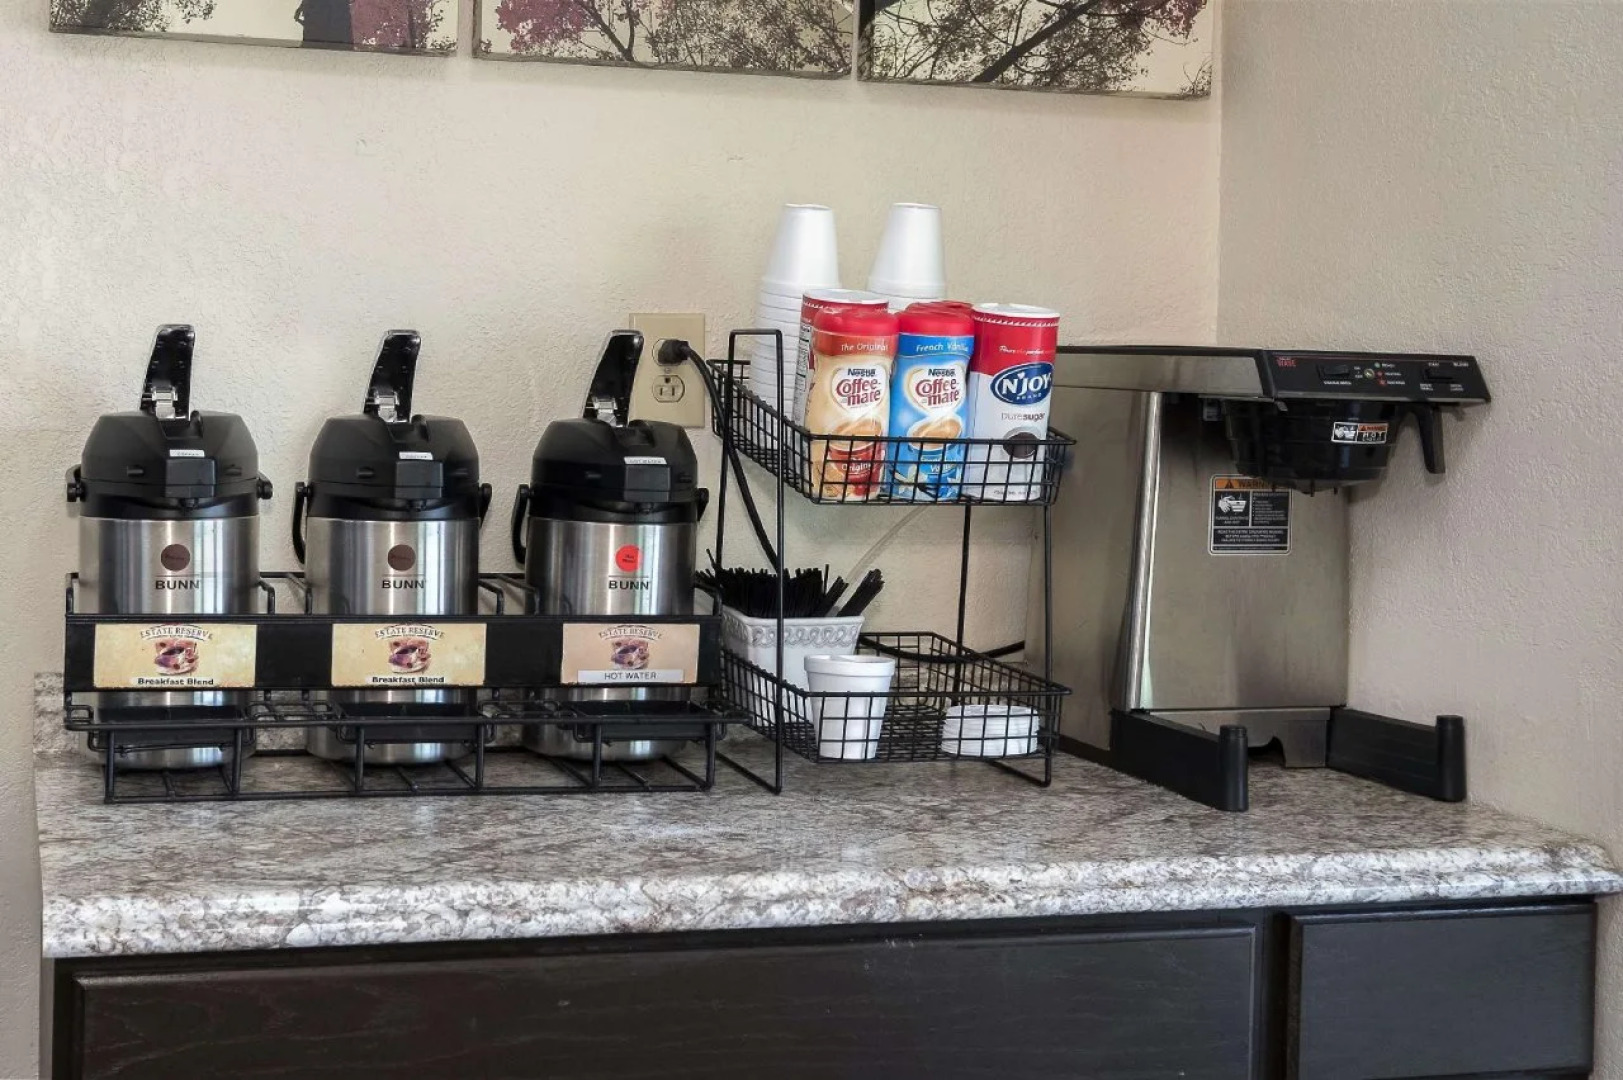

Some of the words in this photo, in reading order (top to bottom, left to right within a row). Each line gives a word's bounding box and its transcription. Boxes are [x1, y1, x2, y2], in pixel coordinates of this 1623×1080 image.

[916, 342, 944, 352] French
[847, 390, 881, 406] mate
[927, 390, 960, 406] mate
[155, 580, 200, 590] BUNN
[382, 580, 424, 589] BUNN
[609, 580, 649, 590] BUNN
[604, 672, 622, 680] HOT
[625, 671, 657, 680] WATER
[137, 677, 185, 686] Breakfast
[187, 677, 214, 686] Blend
